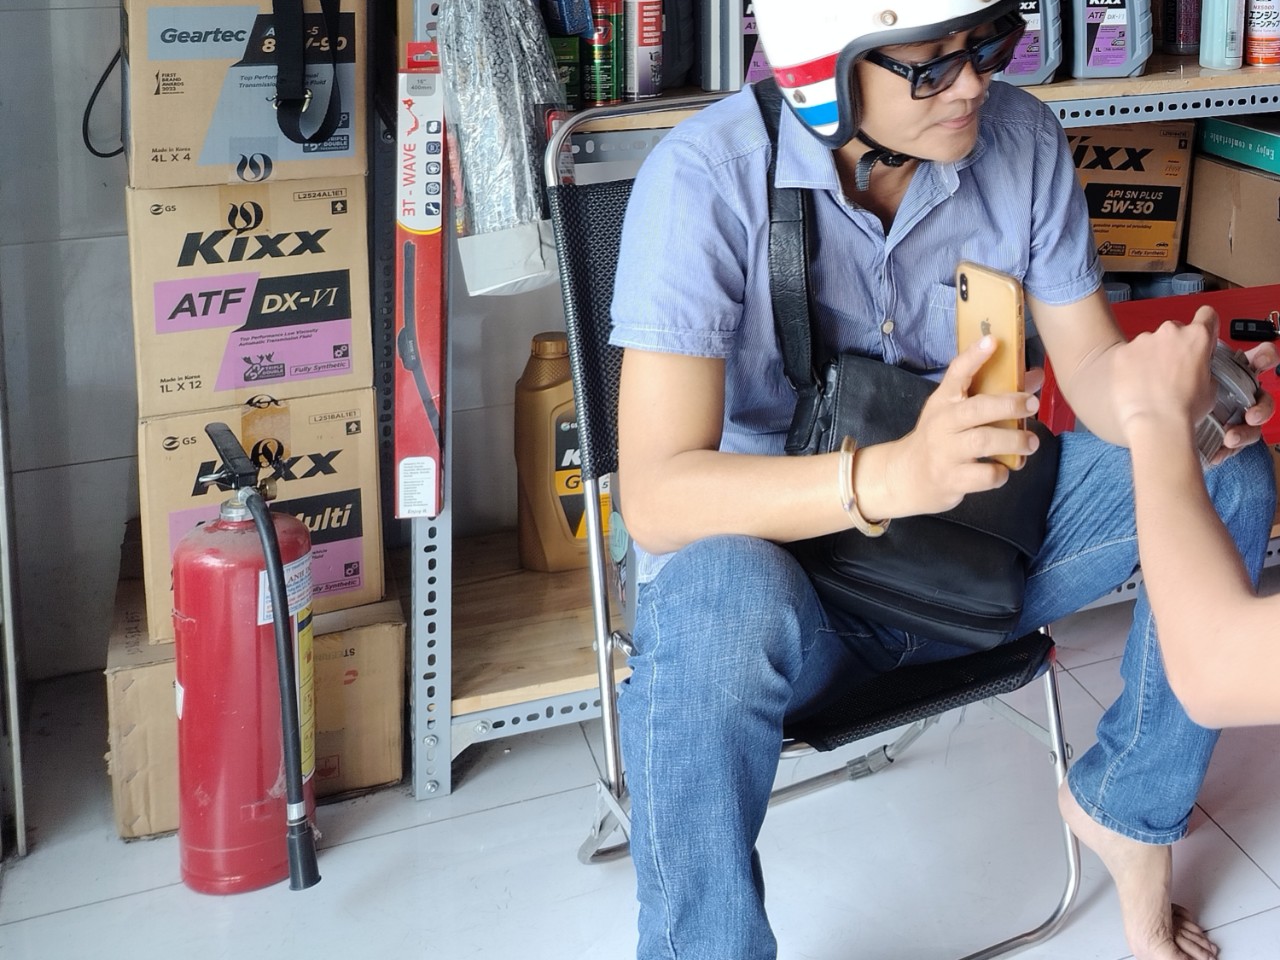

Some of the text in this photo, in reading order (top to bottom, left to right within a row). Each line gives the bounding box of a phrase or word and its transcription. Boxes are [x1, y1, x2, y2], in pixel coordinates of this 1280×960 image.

[1087, 11, 1106, 20] ATF
[1249, 10, 1280, 20] エンジン
[160, 27, 247, 44] Geartec
[1209, 132, 1275, 160] Enjoy a comfortable
[151, 153, 191, 162] 4L X 4
[403, 143, 416, 217] 3T WAVE
[1106, 190, 1163, 200] API SN PLUS
[1100, 200, 1154, 215] 5W-30
[177, 228, 333, 268] Kixx
[167, 288, 247, 320] ATF
[261, 287, 339, 315] DX-VI
[313, 361, 346, 371] Synthetic
[160, 380, 202, 394] 1L X 12
[182, 436, 197, 445] GS
[324, 580, 357, 591] Synthetic
